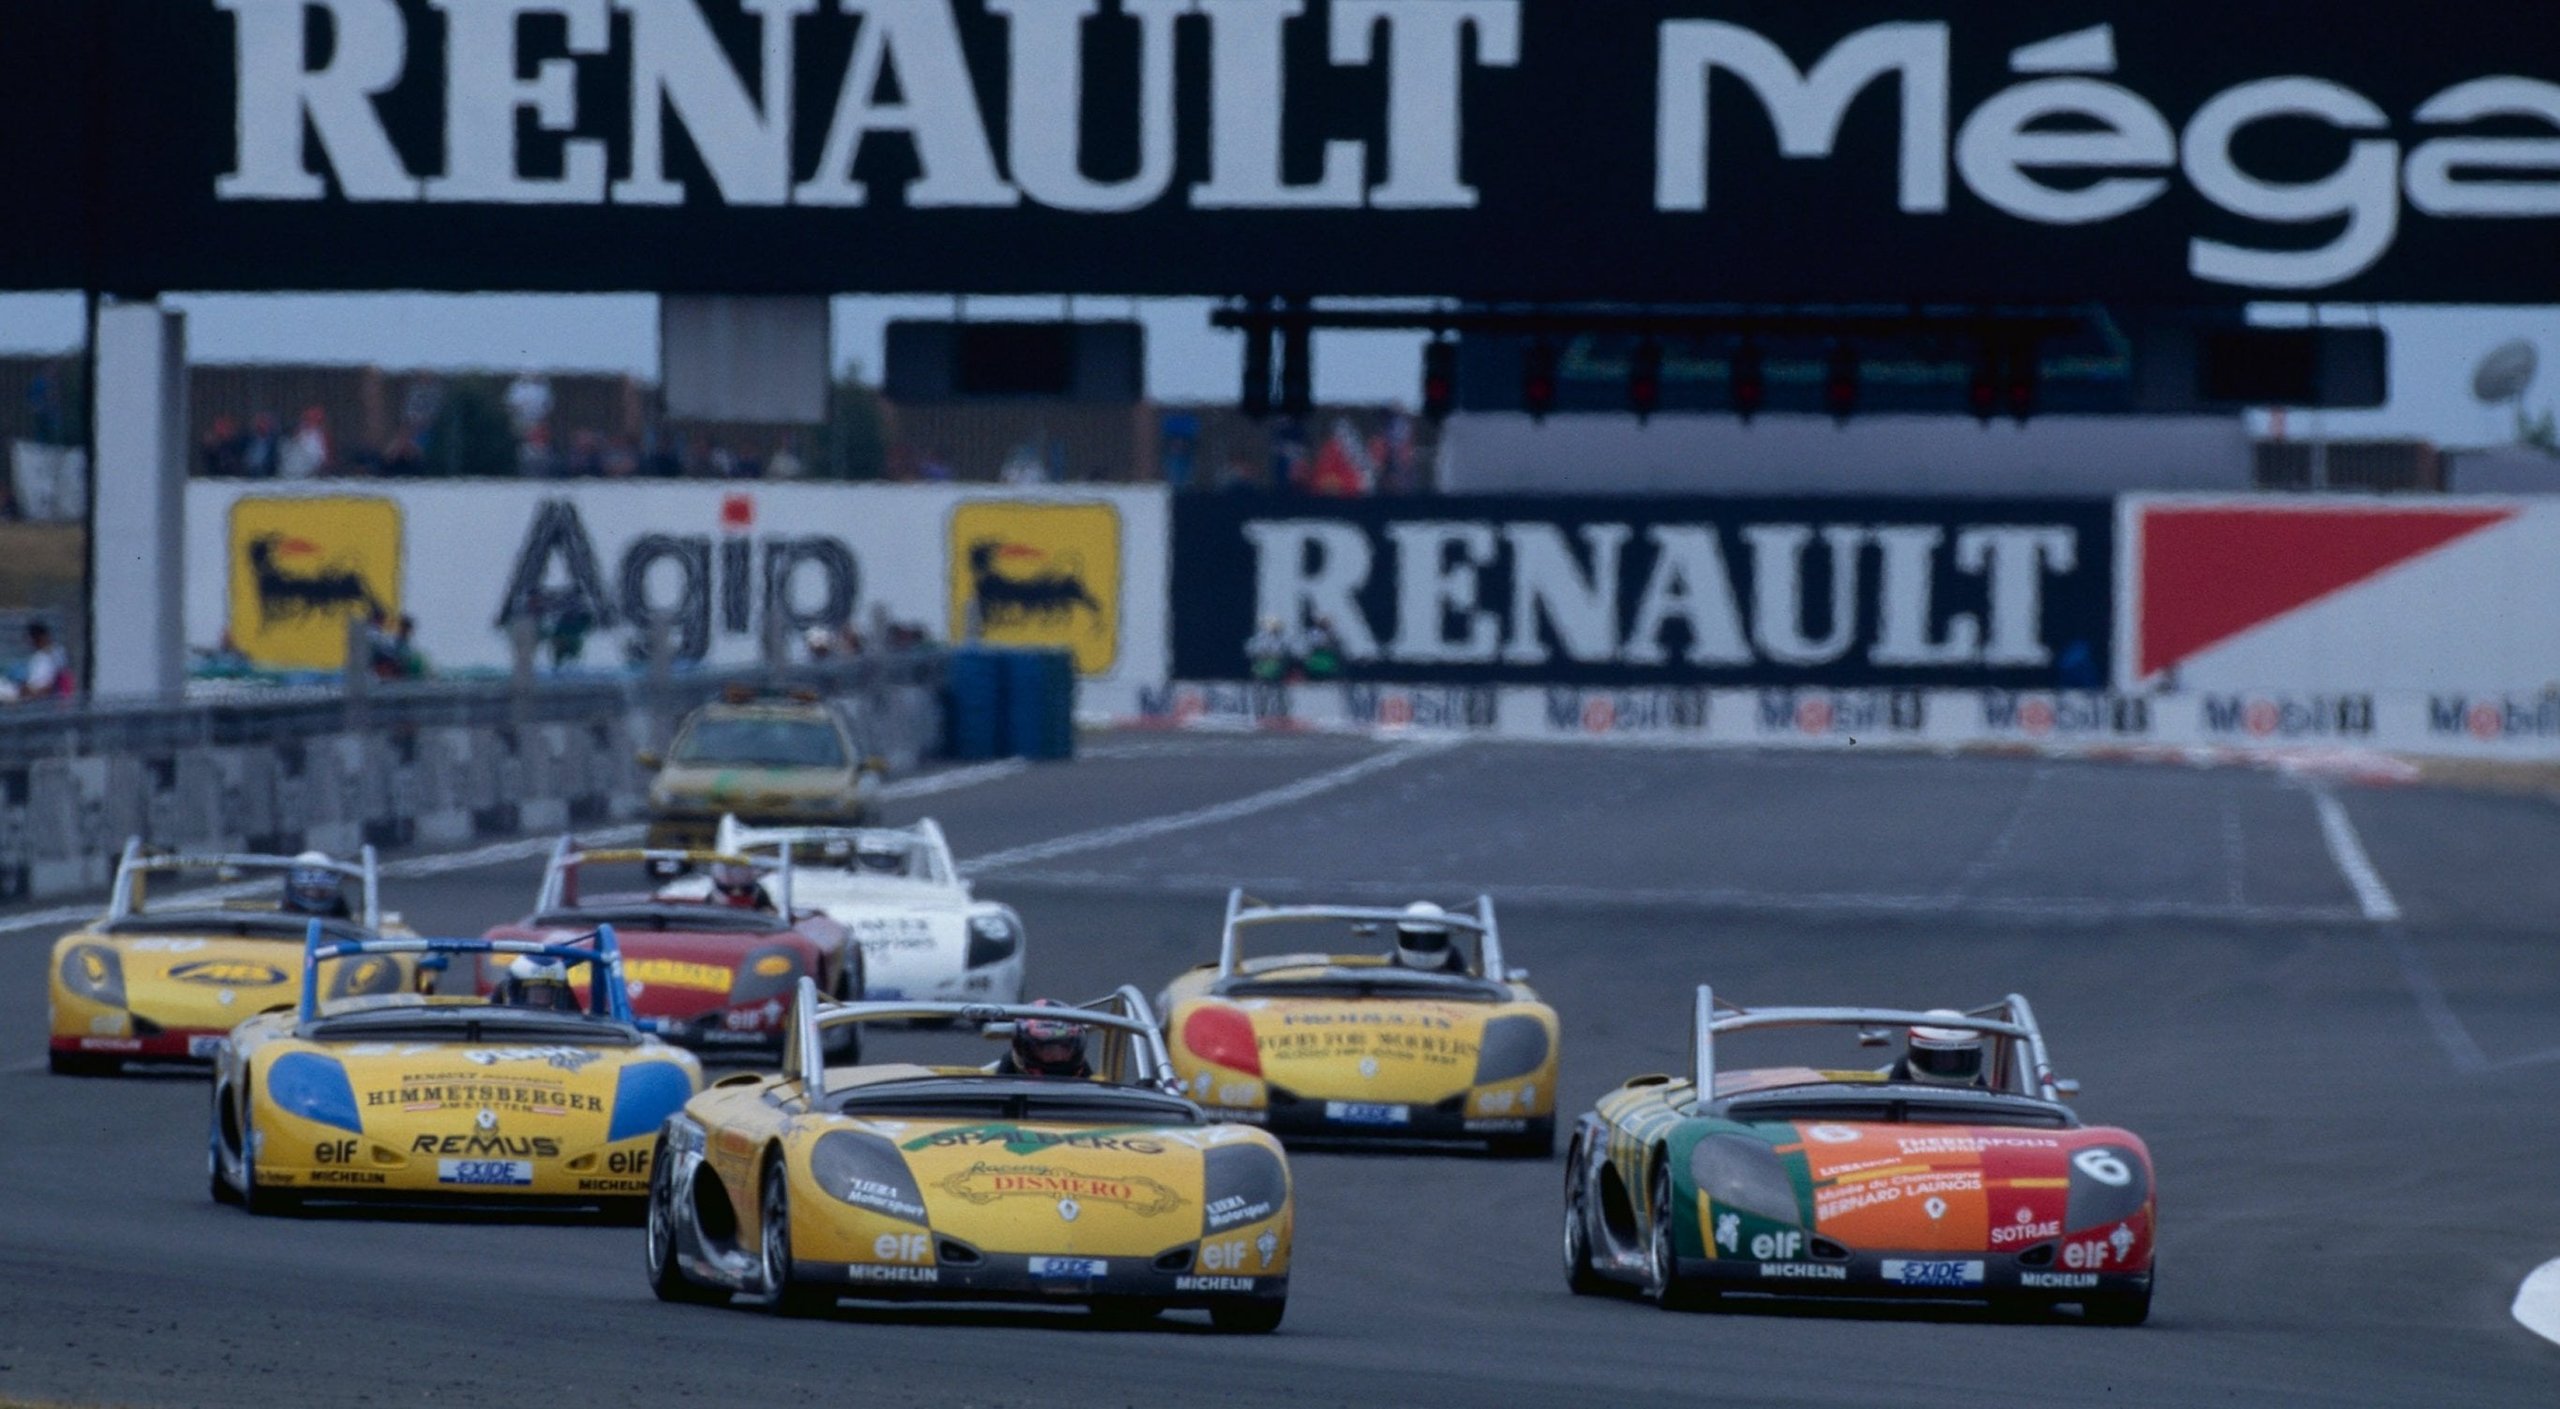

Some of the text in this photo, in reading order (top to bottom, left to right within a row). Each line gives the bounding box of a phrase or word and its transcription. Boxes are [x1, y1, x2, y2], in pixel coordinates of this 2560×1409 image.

[216, 0, 1520, 211] RENAULT
[494, 490, 862, 664] Agip
[1243, 519, 2077, 668] RENAULT
[367, 1085, 604, 1112] HIMMETSBERGER
[314, 1140, 358, 1164] elf
[411, 1135, 560, 1156] REMUS
[455, 1162, 517, 1178] EXIDE
[608, 1150, 648, 1173] elf
[2073, 1149, 2131, 1187] 6
[310, 1170, 386, 1183] MICHELIN
[994, 1175, 1132, 1200] DISMERO
[1816, 1178, 1983, 1222] BERNARD LAUNOIS
[1991, 1220, 2060, 1244] SOTRAE
[873, 1232, 928, 1262] elf
[1202, 1240, 1248, 1270] elf
[1751, 1231, 1801, 1260] elf
[2063, 1241, 2109, 1268] elf
[848, 1264, 938, 1282] MICHELIN
[1760, 1263, 1847, 1279] MICHELIN
[1901, 1262, 1967, 1279] EXIDE
[2020, 1272, 2098, 1287] MICHELIN
[1176, 1276, 1254, 1291] MICHELIN
